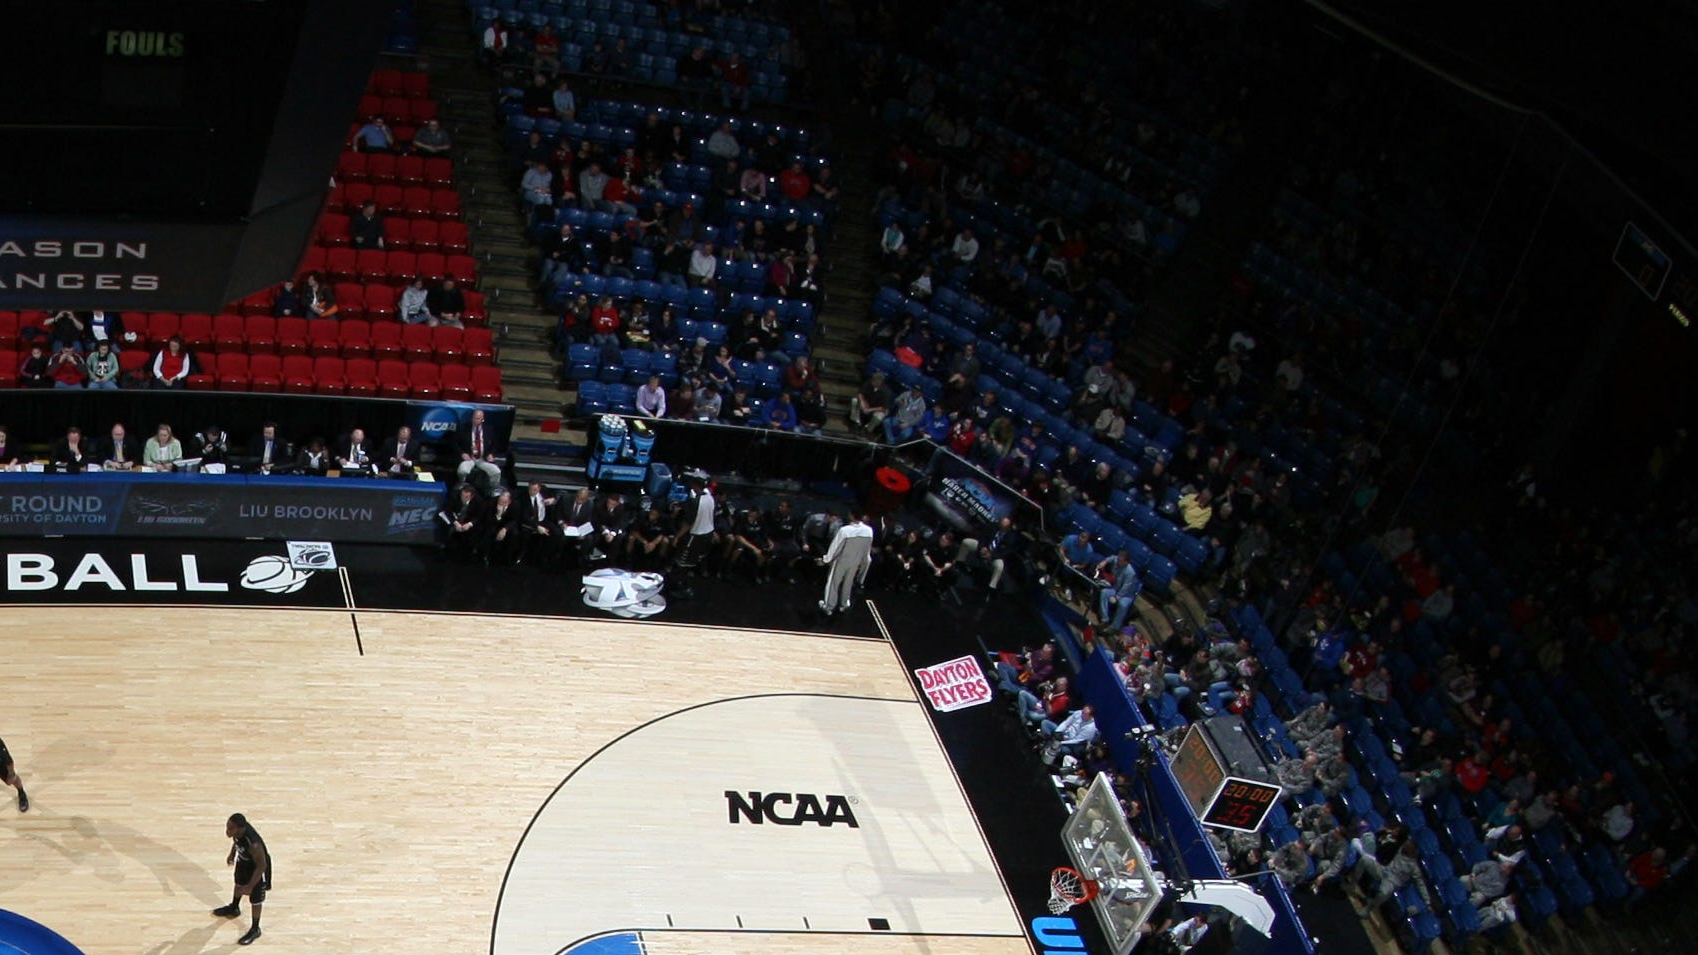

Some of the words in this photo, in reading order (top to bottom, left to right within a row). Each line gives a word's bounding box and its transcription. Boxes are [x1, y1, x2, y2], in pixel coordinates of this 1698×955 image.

[105, 29, 185, 58] FOULS
[12, 496, 102, 512] ROUND
[34, 513, 52, 523] OF
[55, 513, 106, 524] DAYTON
[239, 504, 268, 517] LIU
[274, 505, 373, 521] BROOKLYN
[917, 658, 980, 689] DAYTON
[928, 678, 988, 707] FLYERS
[724, 790, 859, 828] NCAA
